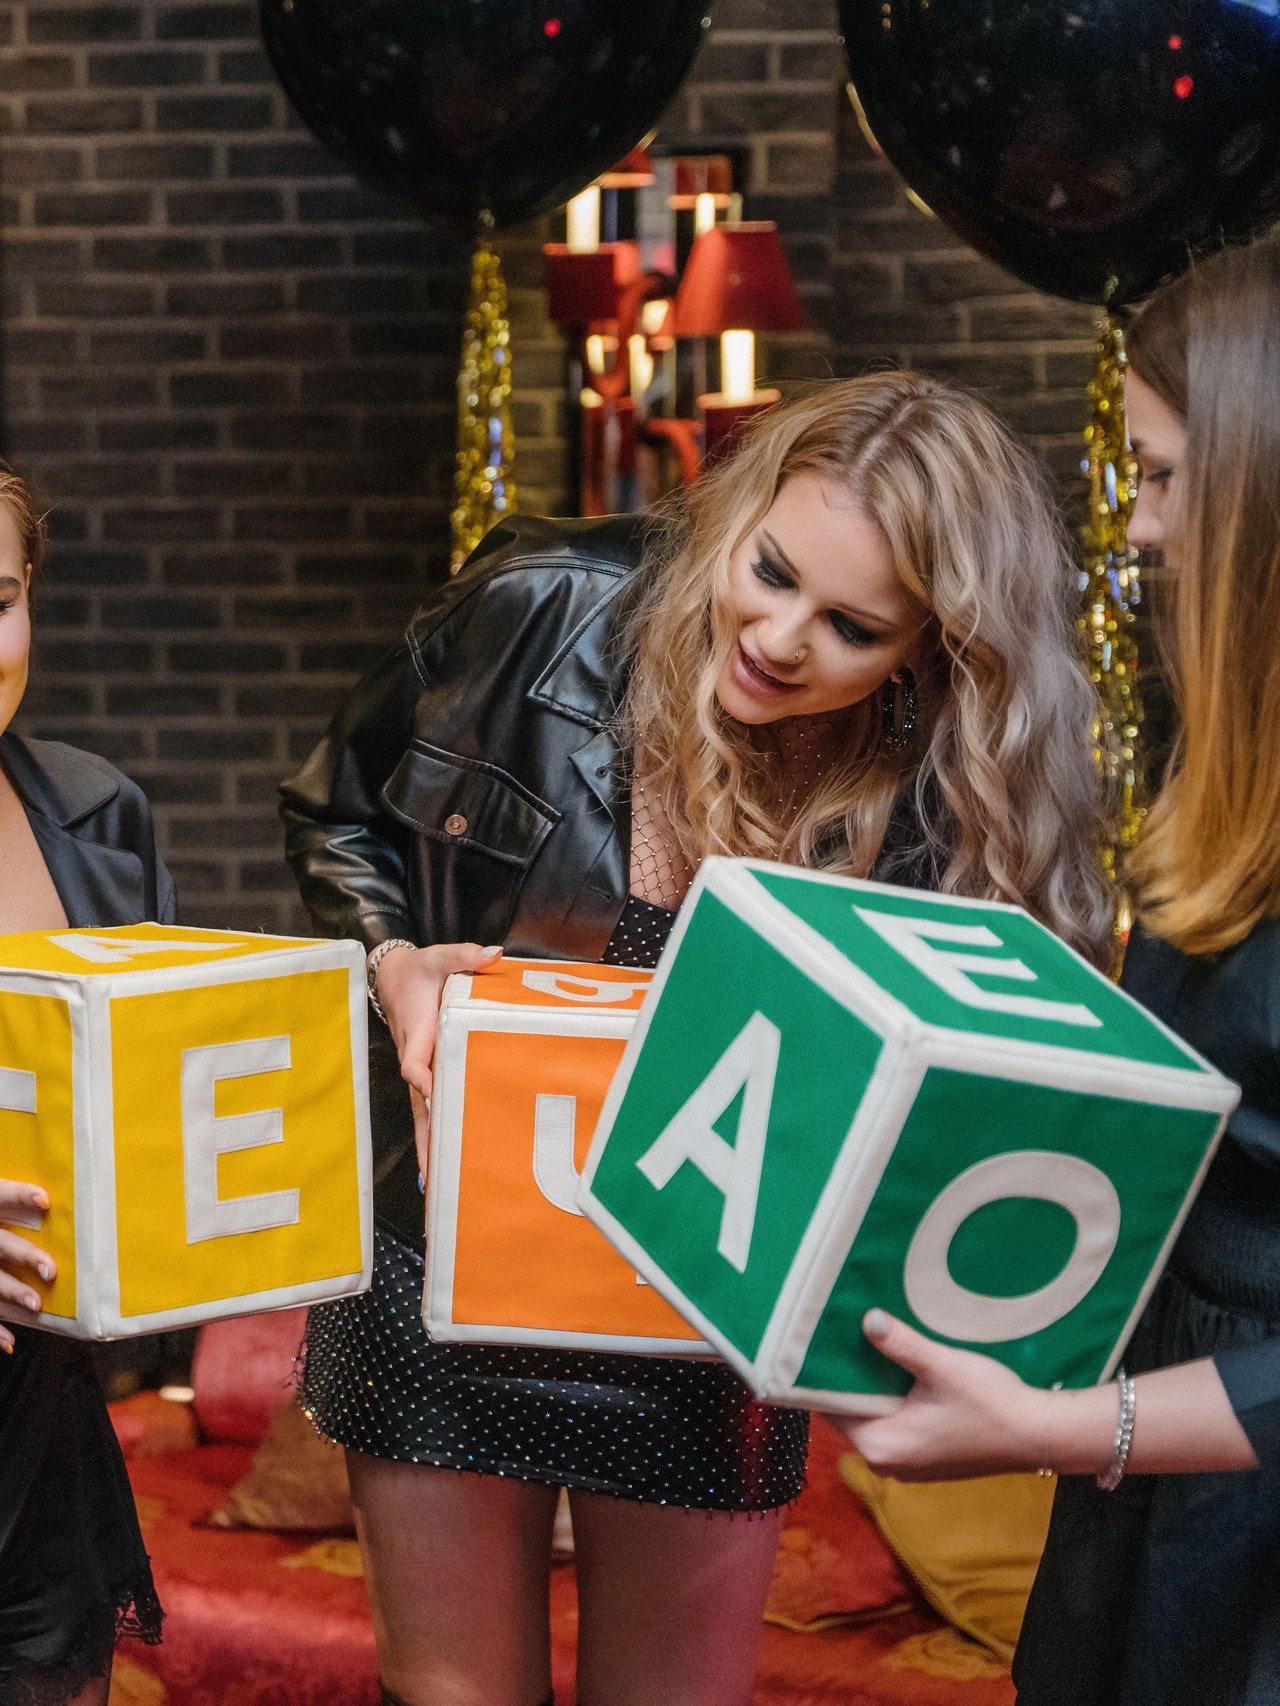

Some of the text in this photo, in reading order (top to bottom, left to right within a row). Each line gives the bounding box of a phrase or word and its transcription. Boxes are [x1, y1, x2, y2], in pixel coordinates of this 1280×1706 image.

[852, 904, 1104, 1028] E
[181, 1034, 301, 1246] E
[635, 1010, 782, 1274] A
[904, 1149, 1121, 1344] O
